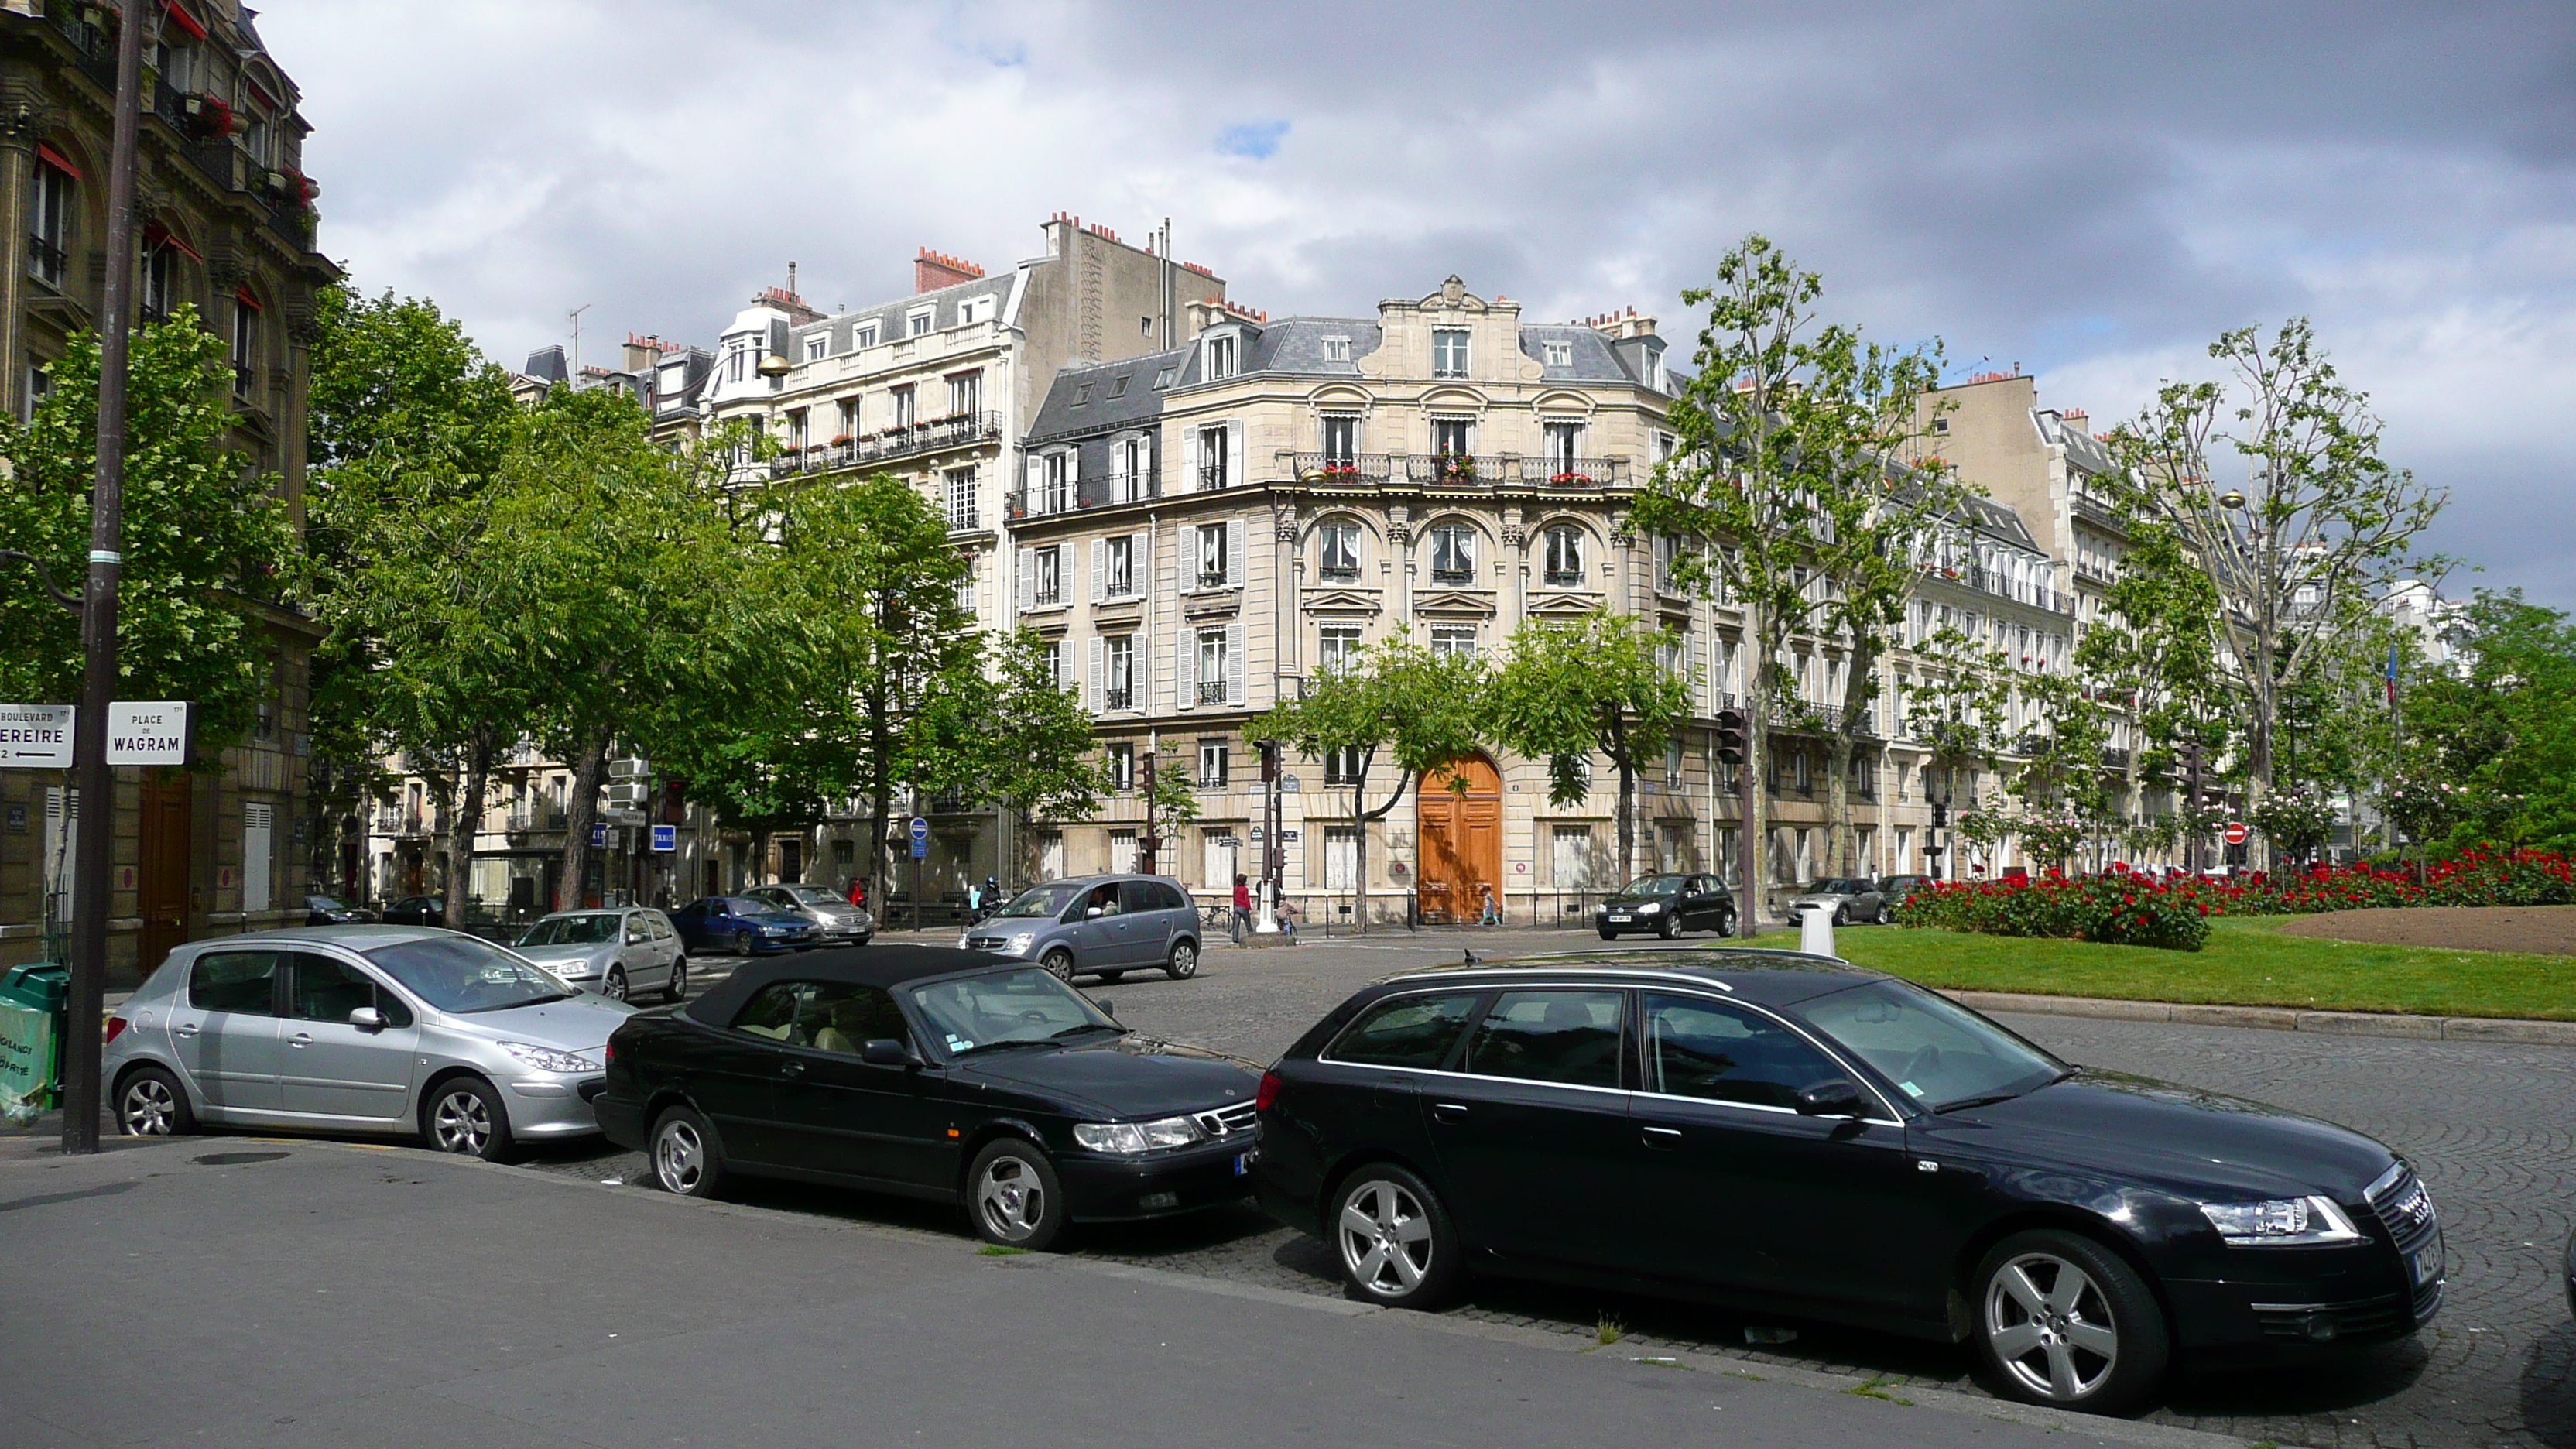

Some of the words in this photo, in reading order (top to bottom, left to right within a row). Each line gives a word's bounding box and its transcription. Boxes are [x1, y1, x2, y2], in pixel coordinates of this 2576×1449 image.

[1, 712, 53, 722] BOULEVARD
[132, 715, 163, 724] PLACE
[114, 737, 179, 752] WAGRAM
[654, 834, 673, 842] TAXIS
